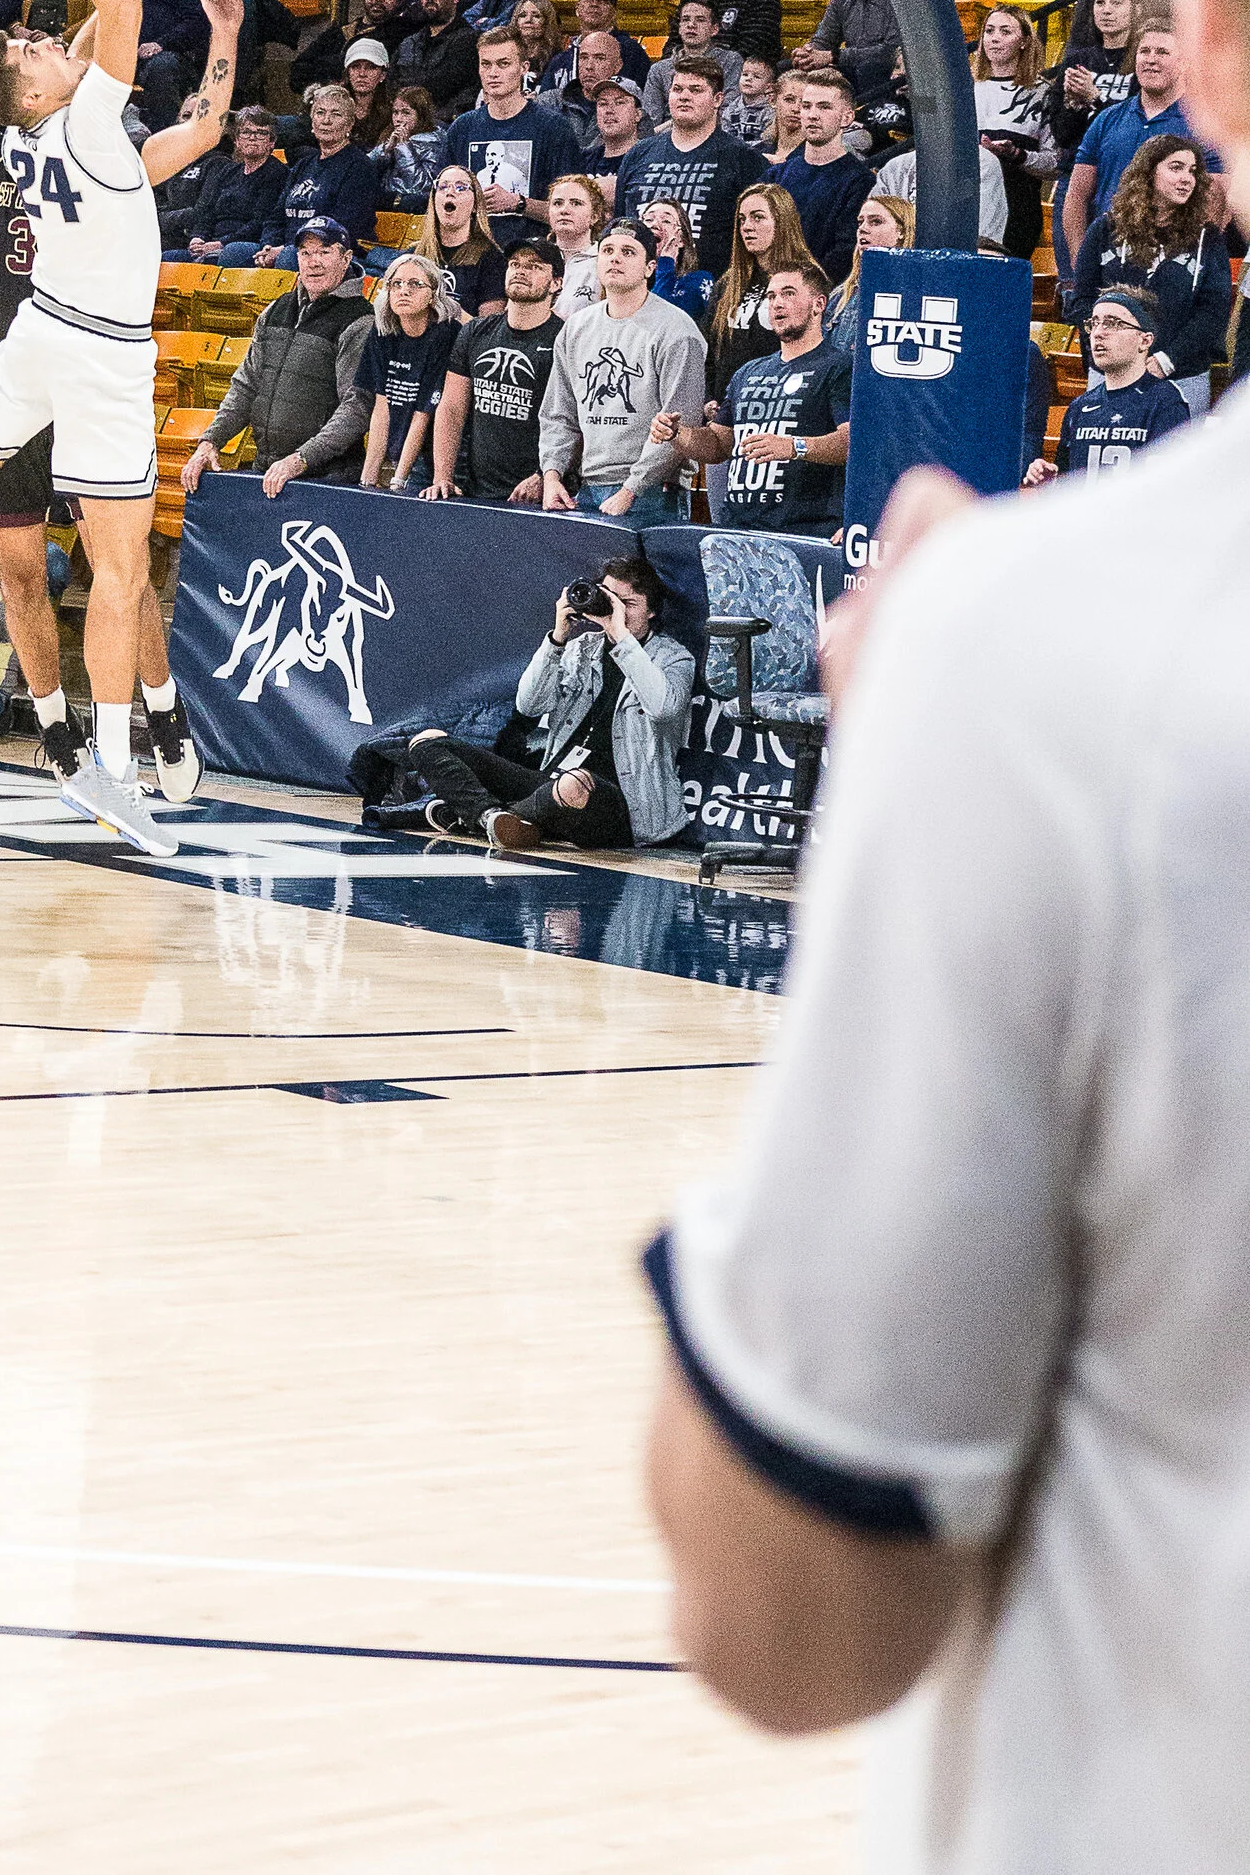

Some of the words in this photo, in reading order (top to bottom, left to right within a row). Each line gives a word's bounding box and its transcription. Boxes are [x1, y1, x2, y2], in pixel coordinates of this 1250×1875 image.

[10, 148, 83, 223] 24
[866, 318, 963, 354] STATE
[473, 388, 533, 409] BASKETBALL
[499, 383, 533, 400] STATE
[474, 400, 530, 422] AGGIES
[604, 416, 629, 426] STATE
[1075, 427, 1109, 441] UTAH
